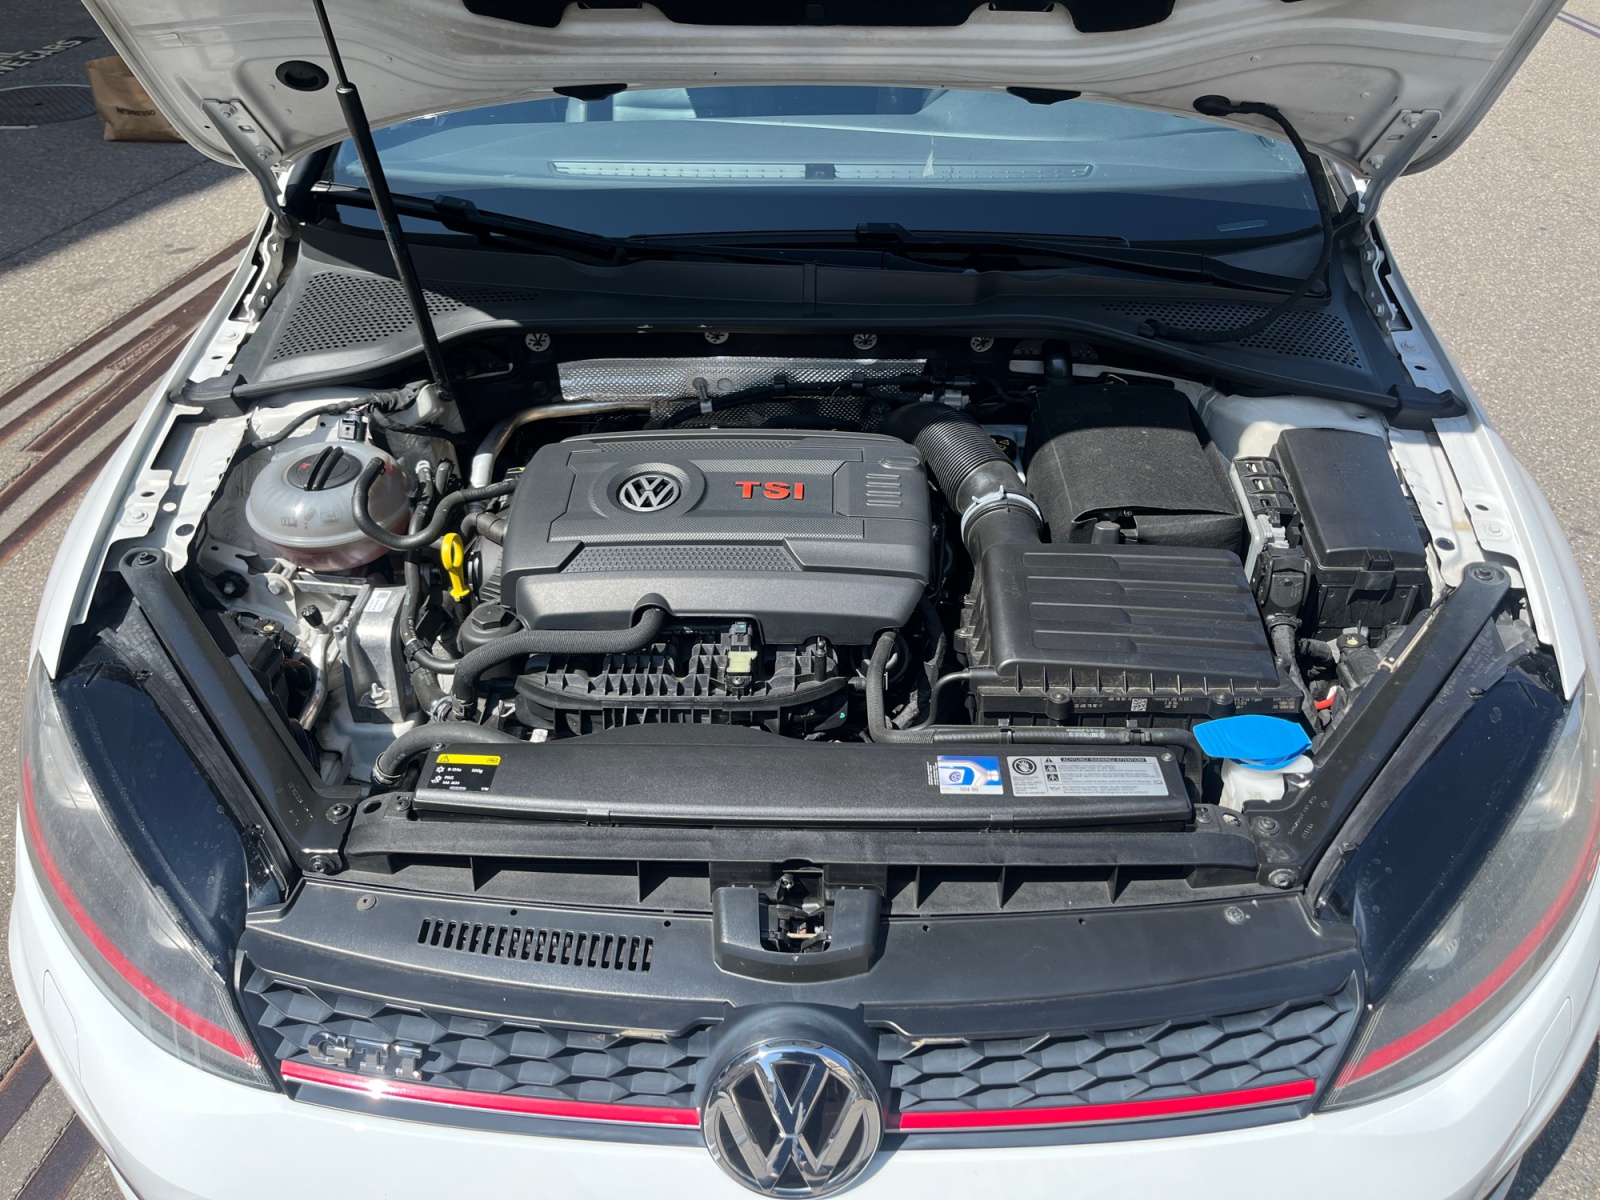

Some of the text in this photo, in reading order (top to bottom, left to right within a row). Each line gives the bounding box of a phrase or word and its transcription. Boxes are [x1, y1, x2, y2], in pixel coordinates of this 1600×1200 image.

[20, 40, 82, 60] CARS
[735, 480, 805, 501] TSI
[308, 1031, 423, 1081] GTI
